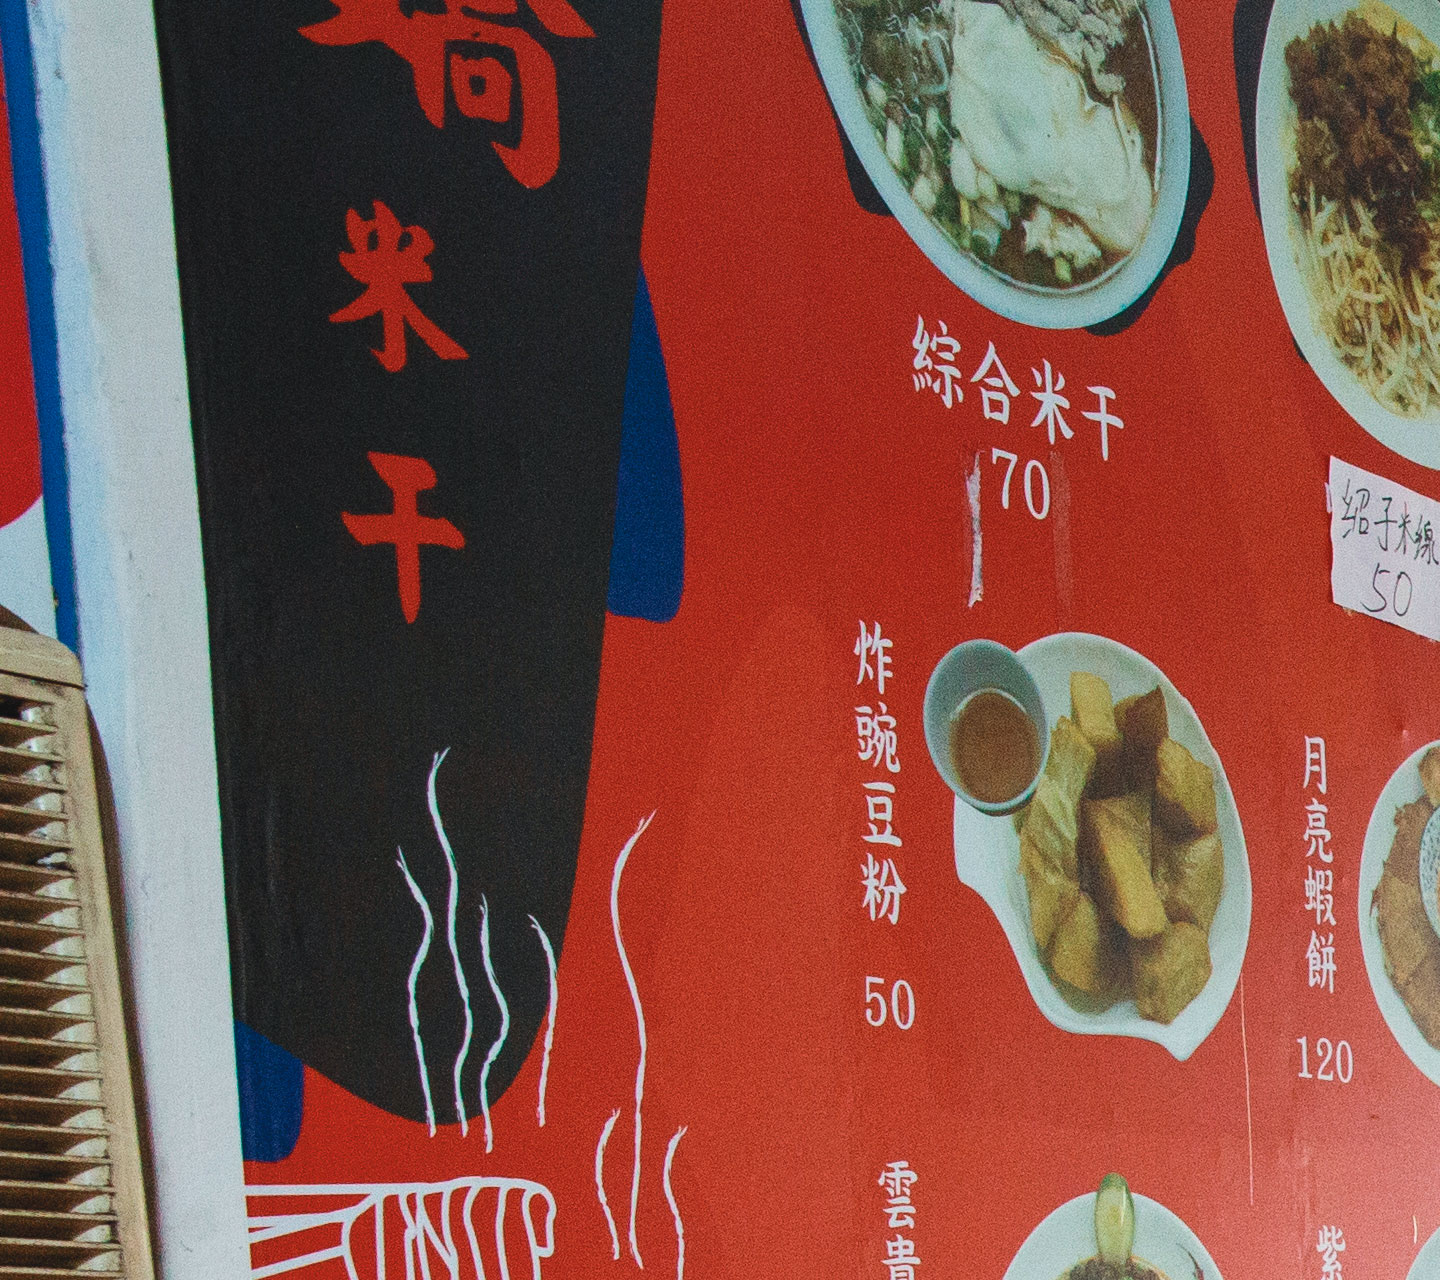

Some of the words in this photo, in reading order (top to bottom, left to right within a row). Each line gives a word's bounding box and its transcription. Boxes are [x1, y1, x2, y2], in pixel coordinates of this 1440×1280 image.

[912, 314, 1124, 462] 綜合米干
[992, 447, 1051, 520] 70
[1361, 562, 1413, 617] 50
[853, 620, 907, 925] 炸豌豆粉
[1301, 735, 1337, 995] 月亮蝦餅
[864, 976, 917, 1030] 50
[1296, 1036, 1354, 1084] 120
